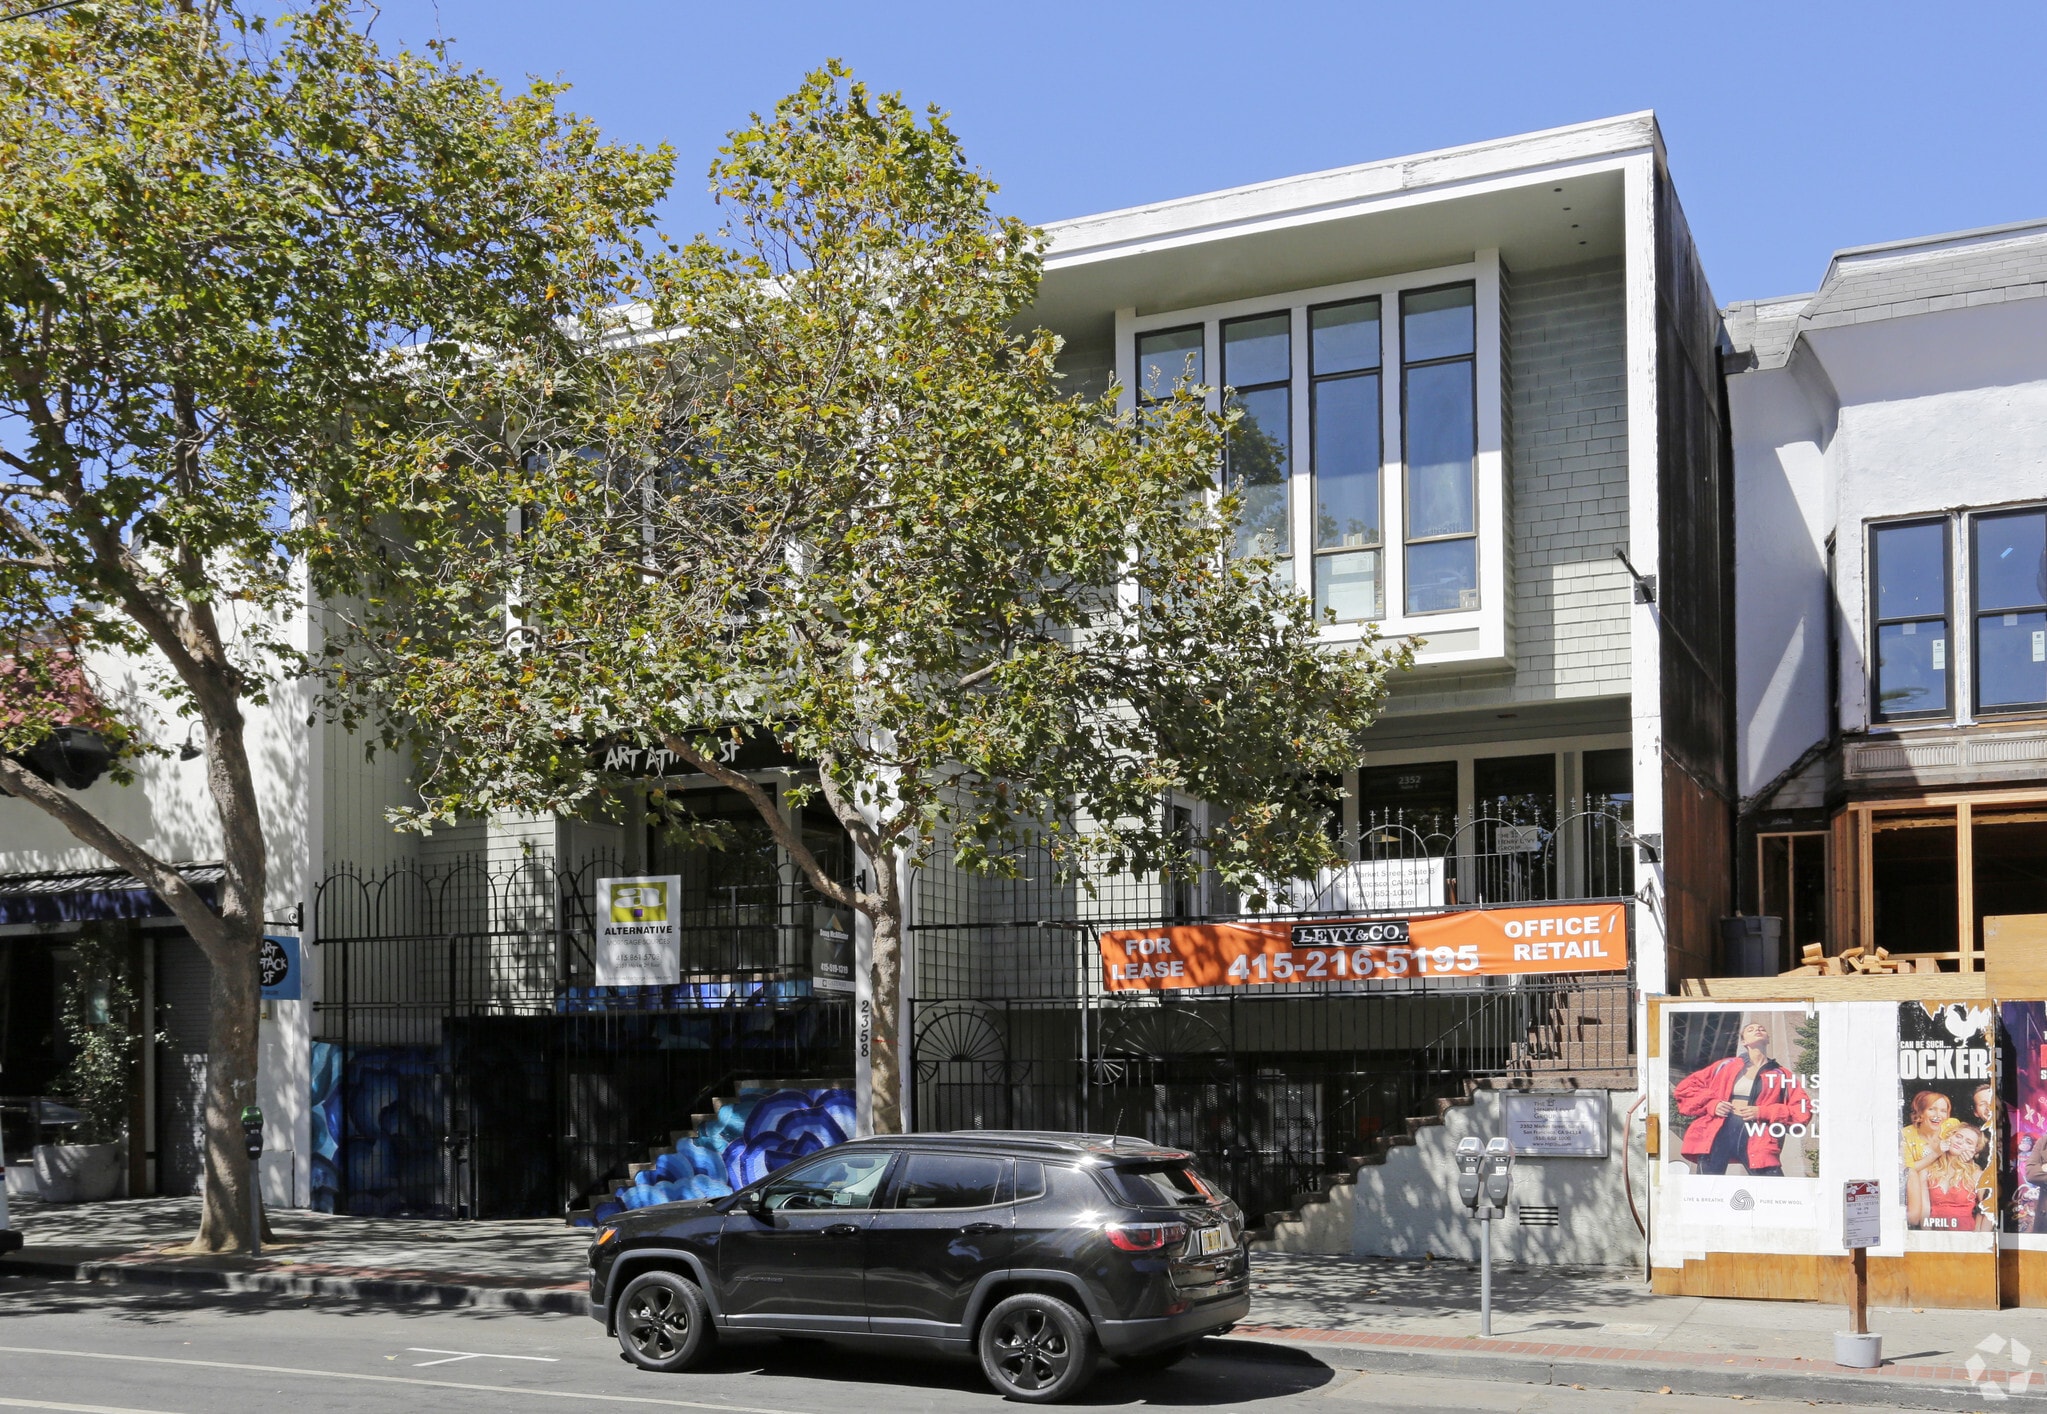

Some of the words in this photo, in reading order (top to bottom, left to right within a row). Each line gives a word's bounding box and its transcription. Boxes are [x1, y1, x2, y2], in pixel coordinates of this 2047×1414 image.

[603, 745, 642, 772] ART
[604, 925, 673, 936] ALTERNATIVE
[1504, 916, 1600, 938] OFFICE
[1125, 938, 1171, 956] FOR
[1514, 940, 1608, 961] RETAIL
[1111, 961, 1184, 980] LEASE
[1228, 945, 1480, 980] 415-216-5195
[262, 970, 275, 984] SF
[860, 1000, 869, 1057] 2358
[1916, 1041, 1924, 1049] BE
[1765, 1074, 1820, 1089] THIS
[1801, 1098, 1820, 1114] IS
[1744, 1122, 1820, 1138] WOOL
[1923, 1218, 1950, 1228] APRIL
[1951, 1218, 1957, 1228] 6
